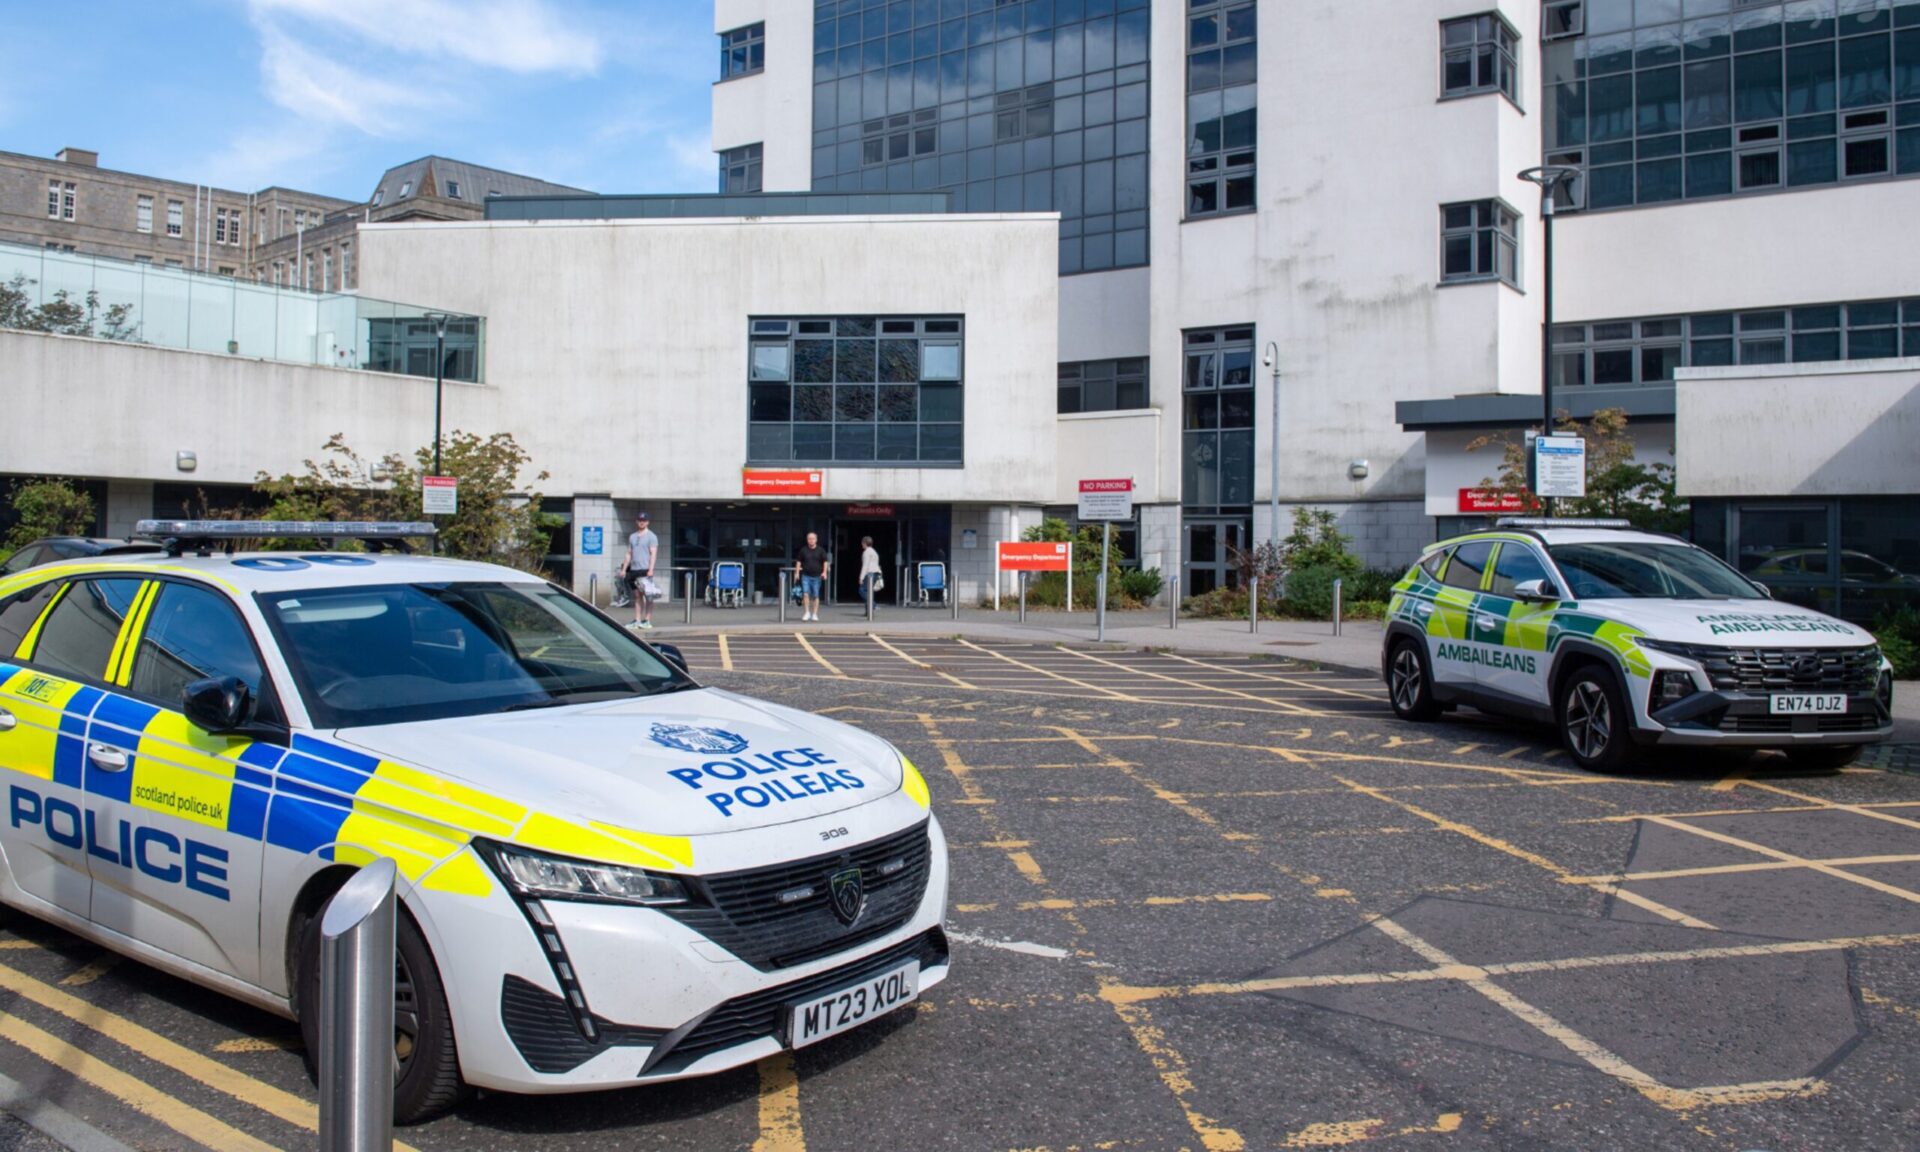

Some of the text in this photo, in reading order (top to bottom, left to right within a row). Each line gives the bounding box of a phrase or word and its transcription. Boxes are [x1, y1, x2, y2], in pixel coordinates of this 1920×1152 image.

[746, 478, 805, 486] Emergency Department
[1083, 481, 1127, 490] NO PARKING
[876, 507, 891, 515] Only
[1001, 553, 1065, 561] Emergency Department
[1710, 622, 1855, 635] AMBAILEANS
[1437, 643, 1536, 674] AMBAILEANS
[1777, 697, 1842, 711] EN74 DJZ
[667, 748, 838, 789] POLICE
[706, 769, 865, 817] POILEAS
[135, 785, 223, 820] scotland police.uk
[819, 827, 849, 841] 308
[10, 785, 230, 901] POLICE
[803, 971, 910, 1038] MT23 XOL
